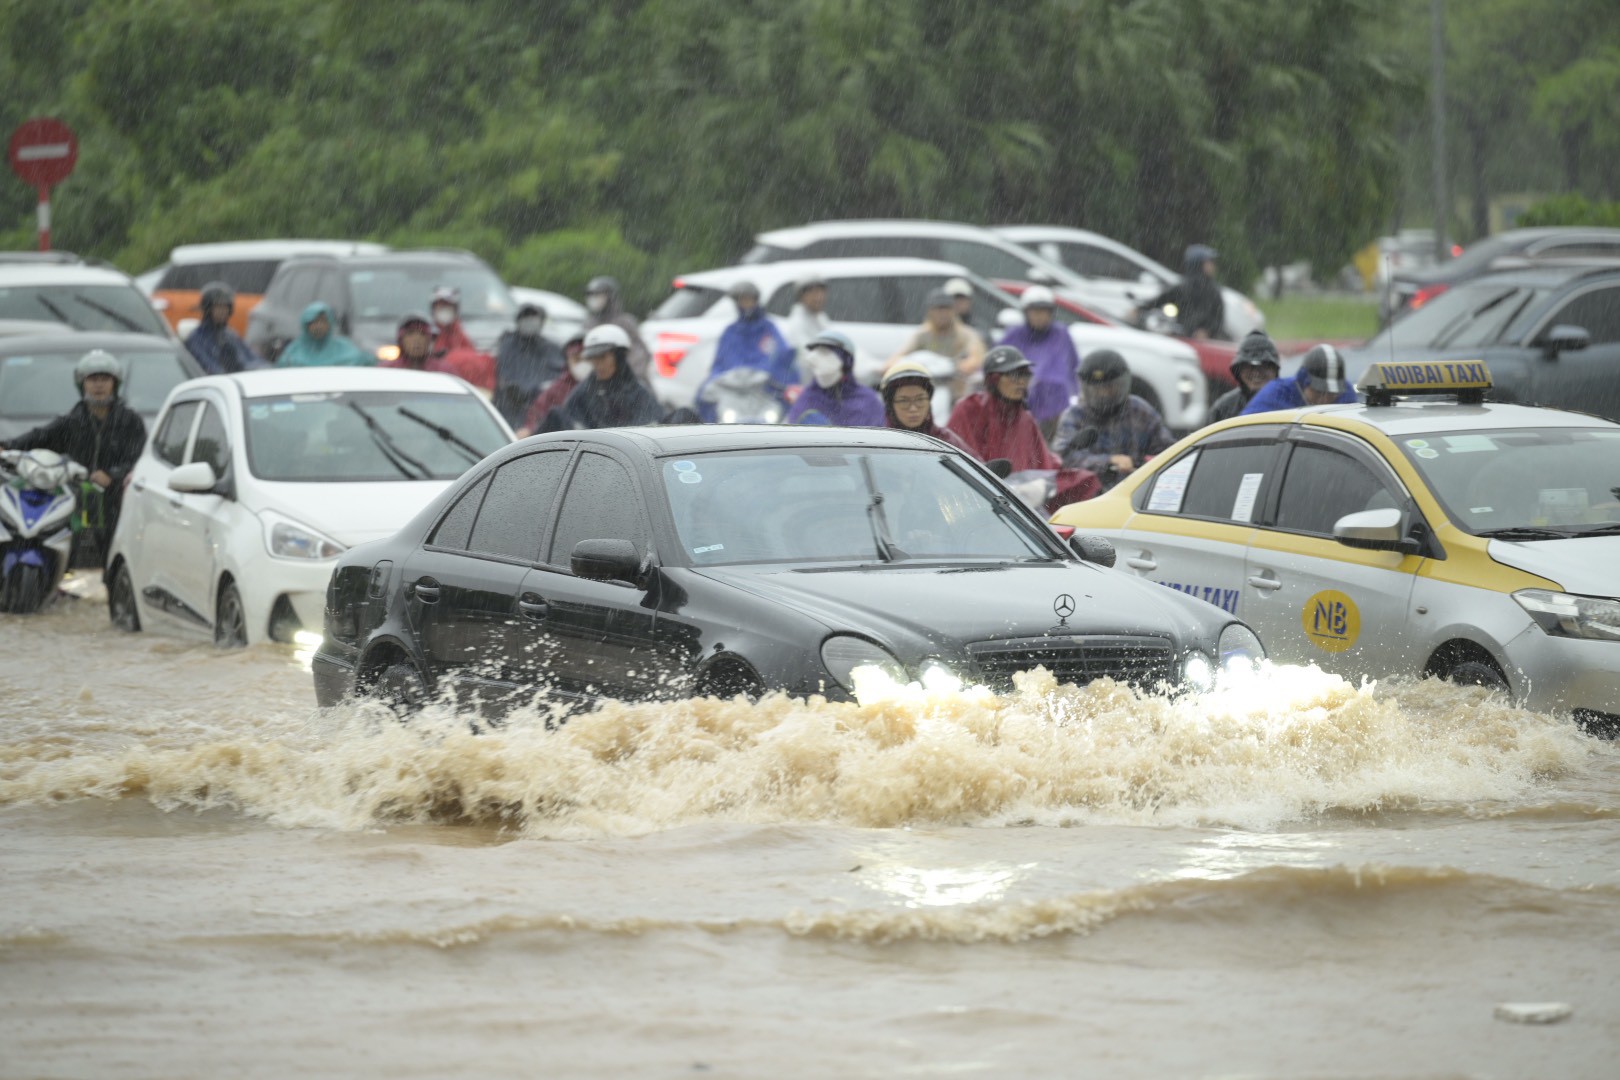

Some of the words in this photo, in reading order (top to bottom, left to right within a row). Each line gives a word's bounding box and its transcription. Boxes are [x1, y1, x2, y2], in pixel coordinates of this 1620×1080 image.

[1381, 365, 1444, 385] NOIBAI
[1444, 363, 1487, 384] TAXI
[1314, 599, 1347, 635] NB
